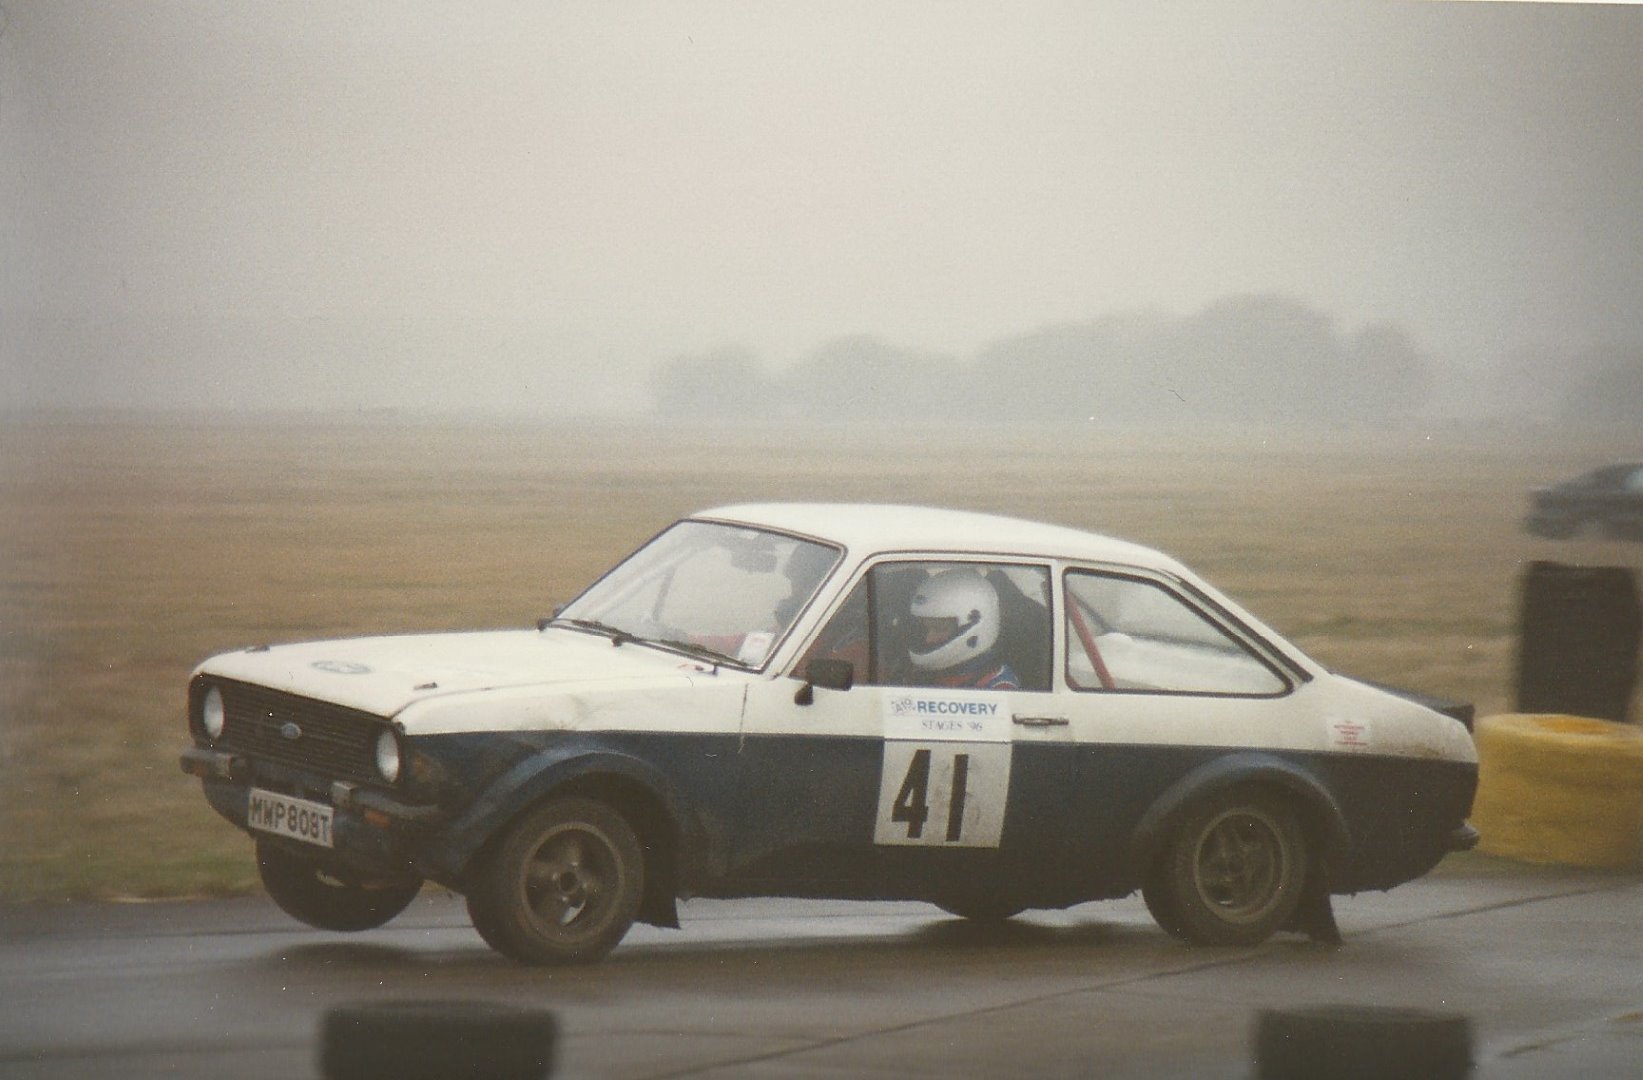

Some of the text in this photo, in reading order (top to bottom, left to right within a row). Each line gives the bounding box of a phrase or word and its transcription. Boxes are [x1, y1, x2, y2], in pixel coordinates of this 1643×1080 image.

[917, 701, 997, 715] RECOVERY
[922, 719, 963, 730] STAGES
[891, 749, 969, 842] 41
